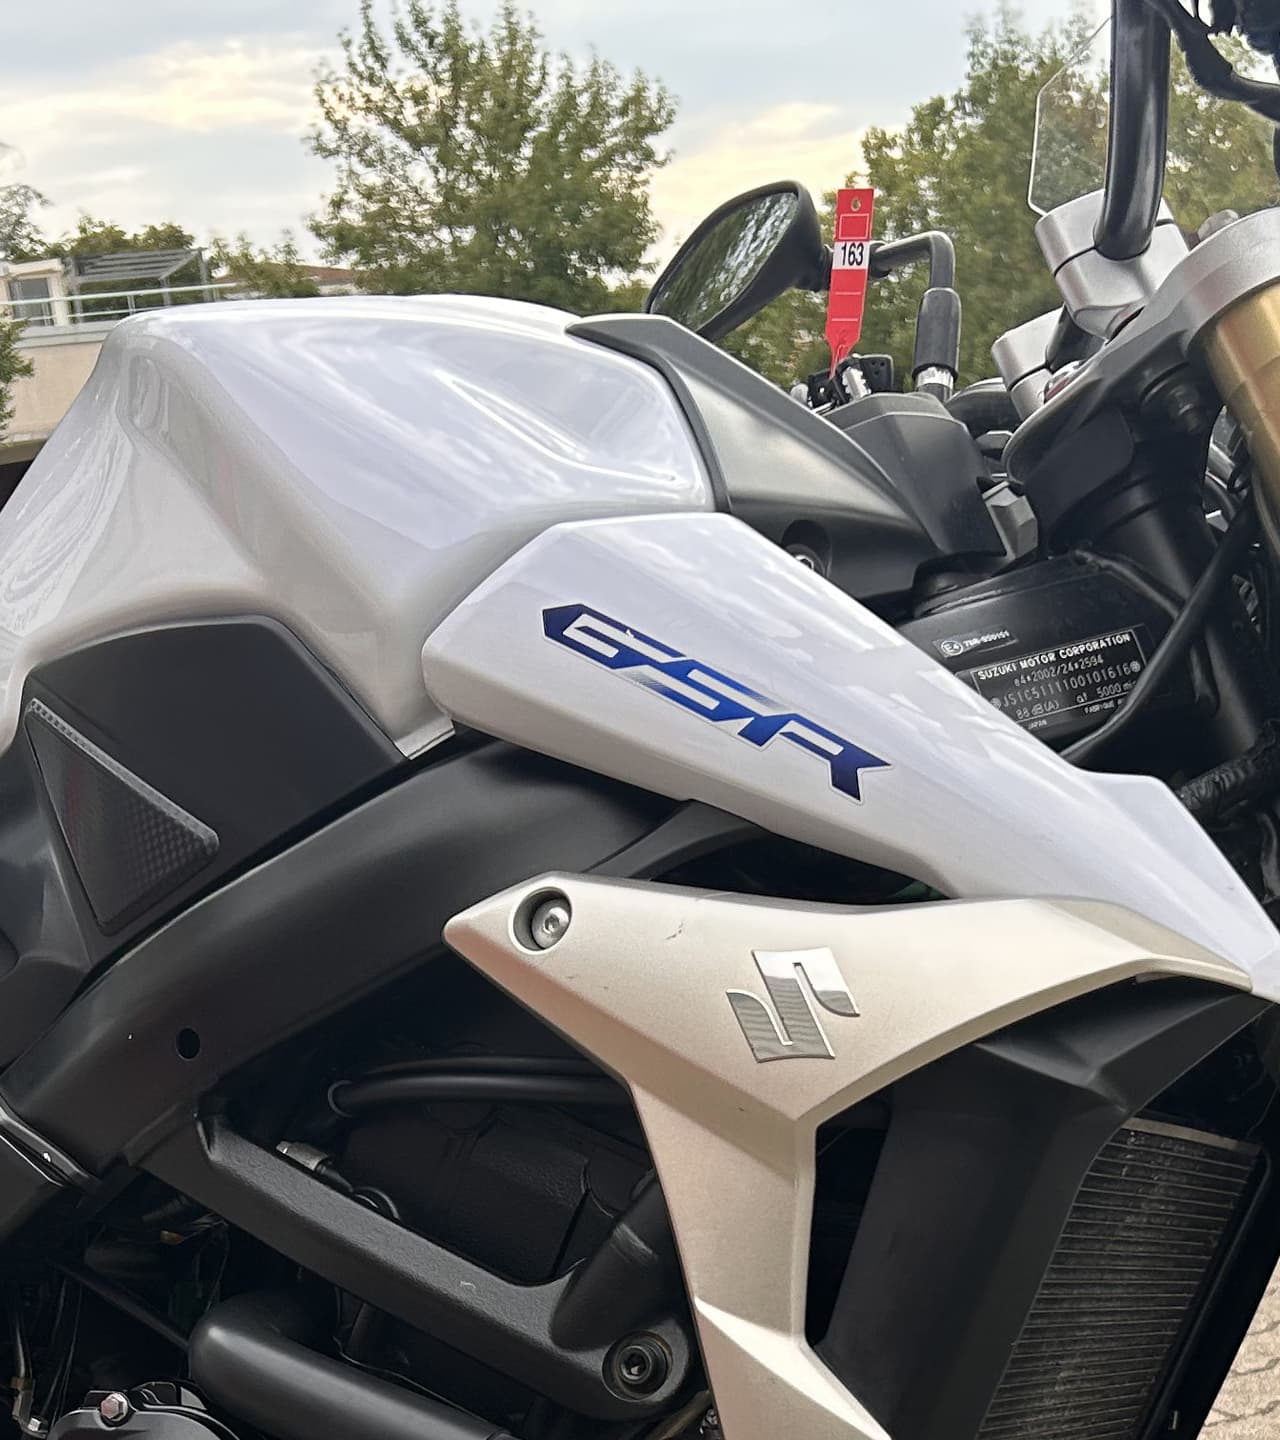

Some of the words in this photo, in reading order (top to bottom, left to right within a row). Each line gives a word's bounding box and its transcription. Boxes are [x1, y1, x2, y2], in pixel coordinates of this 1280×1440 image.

[841, 242, 864, 266] 163
[977, 662, 1017, 680] SUZUKI
[1019, 652, 1056, 669] MOTOR
[1059, 633, 1131, 659] CORPORATION
[542, 603, 892, 802] GSR
[1096, 682, 1122, 698] 5000
